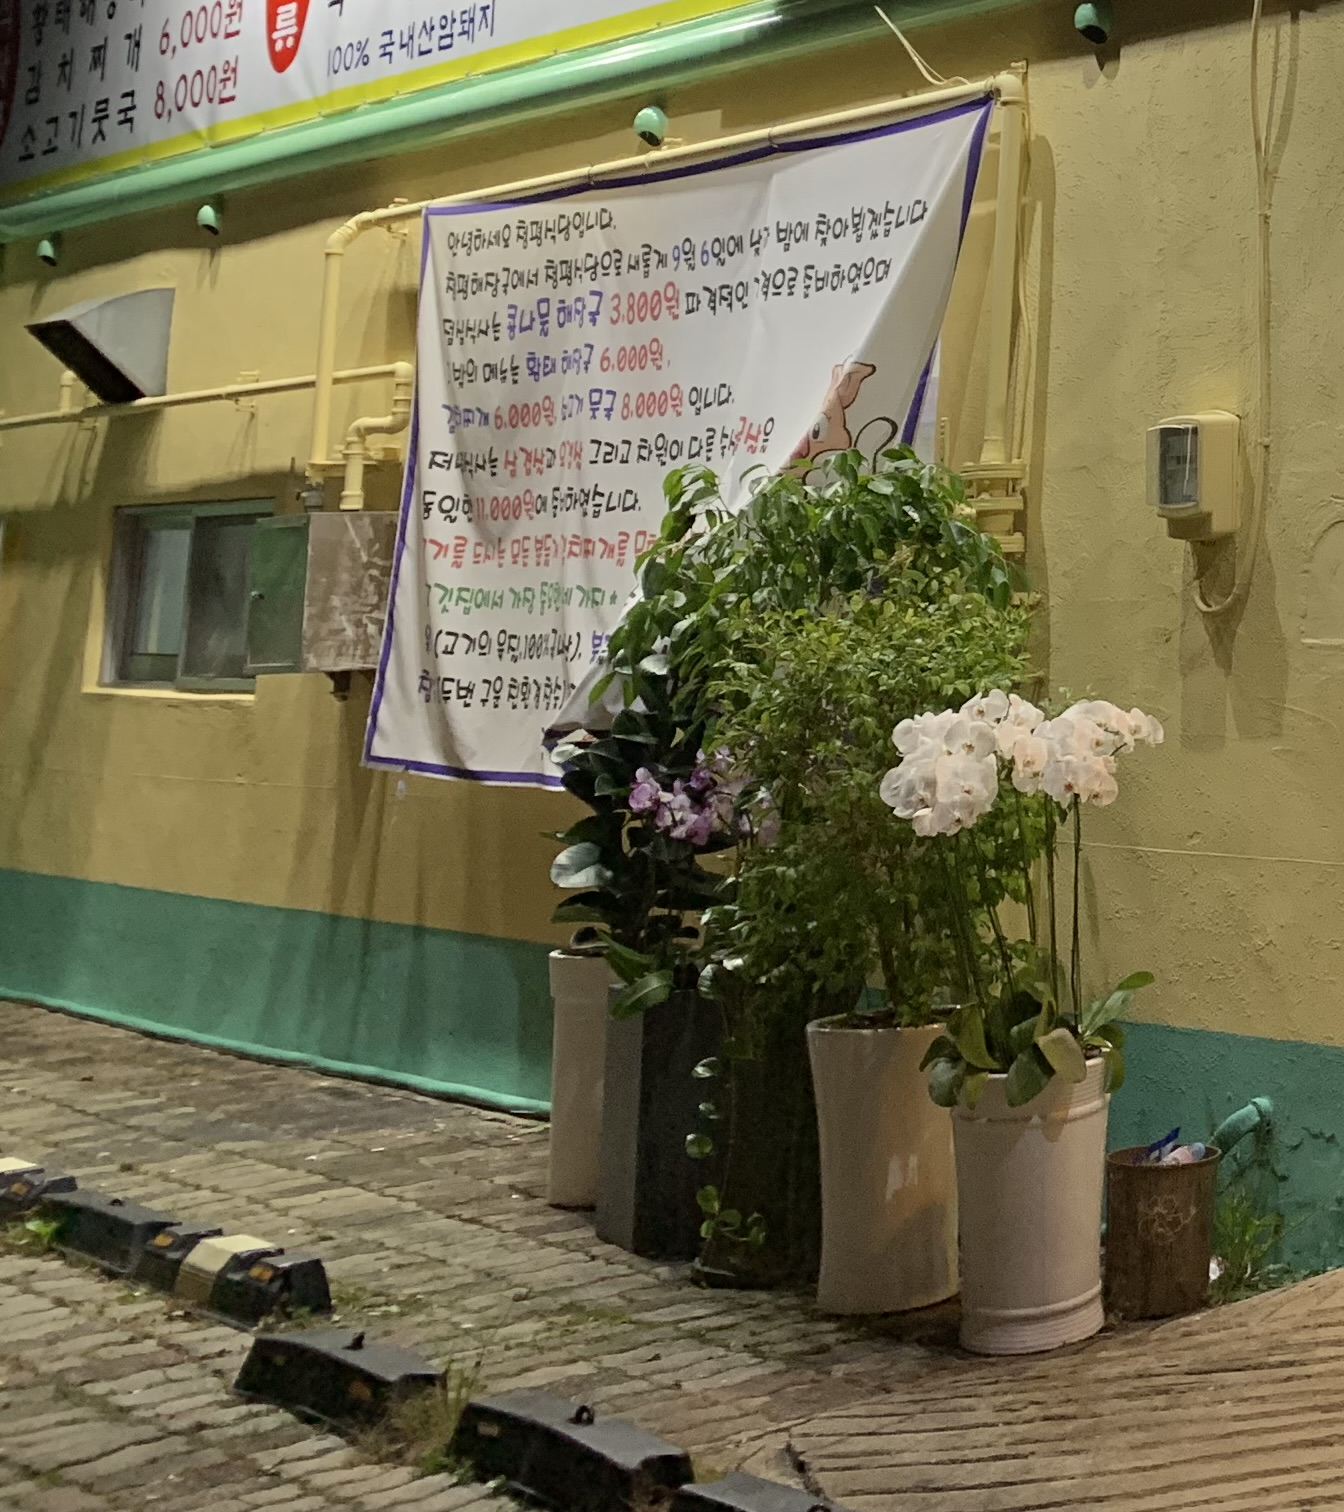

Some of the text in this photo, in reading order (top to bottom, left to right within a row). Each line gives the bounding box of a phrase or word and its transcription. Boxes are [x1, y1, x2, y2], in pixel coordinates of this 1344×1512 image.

[327, 38, 370, 77] 100%
[154, 55, 238, 123] 8,000원
[424, 535, 468, 569] 기를
